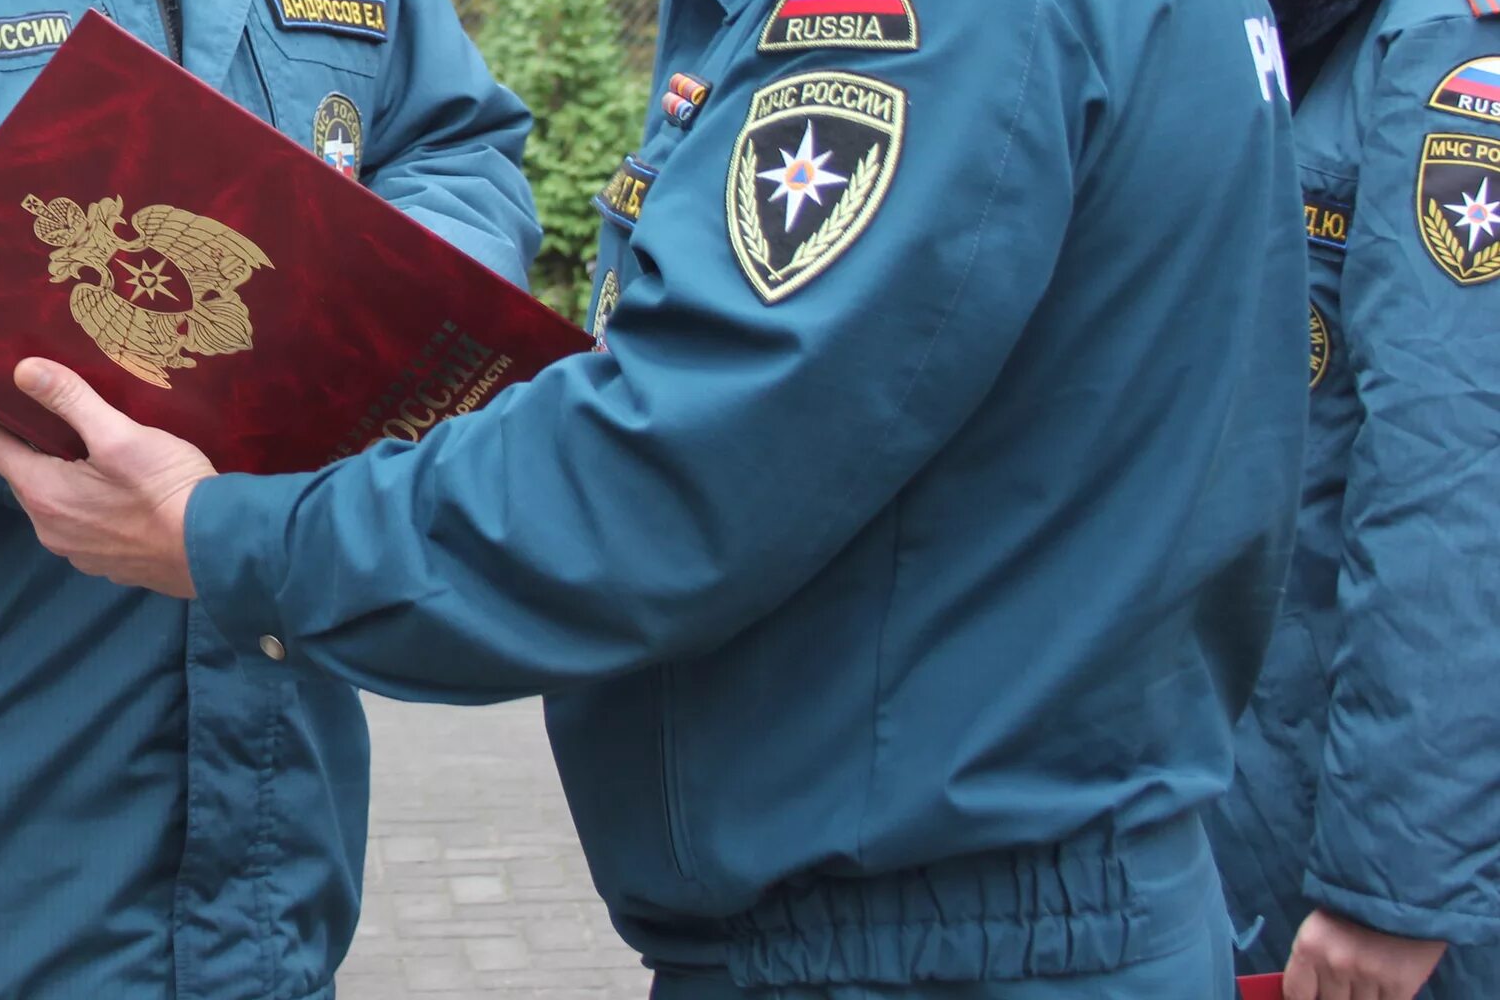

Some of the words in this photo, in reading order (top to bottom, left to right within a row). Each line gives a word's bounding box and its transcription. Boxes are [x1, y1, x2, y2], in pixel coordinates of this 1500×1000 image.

[786, 15, 884, 41] RUSSIA
[758, 86, 798, 118] МЧС
[801, 81, 893, 121] РОССИИ
[1430, 140, 1472, 157] МЧС
[370, 332, 494, 445] ОССИИ
[456, 354, 513, 416] ОБЛАСТИ
